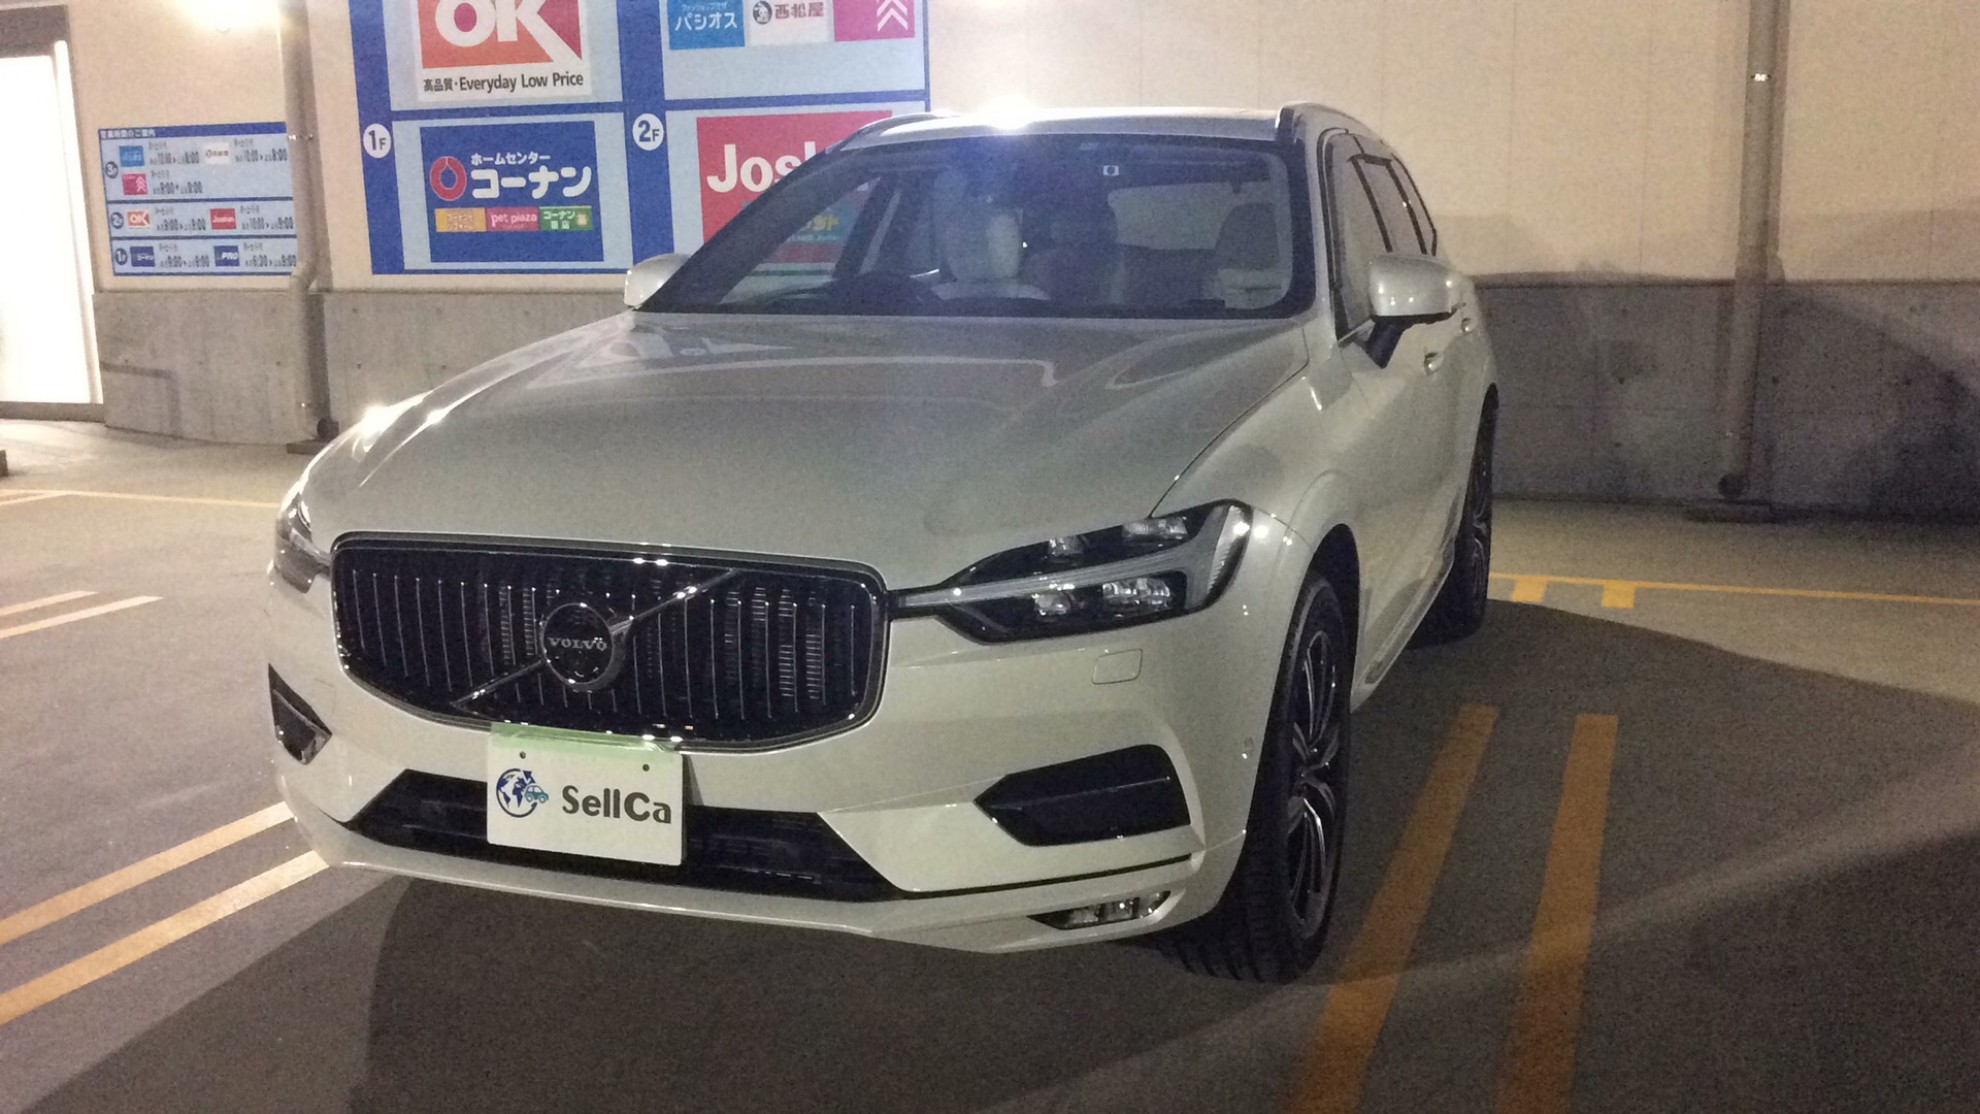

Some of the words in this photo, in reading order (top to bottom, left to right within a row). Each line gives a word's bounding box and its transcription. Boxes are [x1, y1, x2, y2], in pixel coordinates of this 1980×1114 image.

[775, 2, 824, 19] 西松屋
[674, 12, 738, 31] パシオス
[435, 0, 582, 62] OK
[521, 74, 548, 88] Low
[552, 71, 584, 86] Price
[471, 151, 551, 166] ホームセンター
[470, 165, 592, 199] コーナン
[129, 211, 151, 227] OK
[491, 212, 509, 228] pet
[511, 211, 538, 224] plaza
[543, 210, 576, 220] コーナン
[547, 637, 607, 651] VOLVO
[561, 785, 672, 824] SellCa
